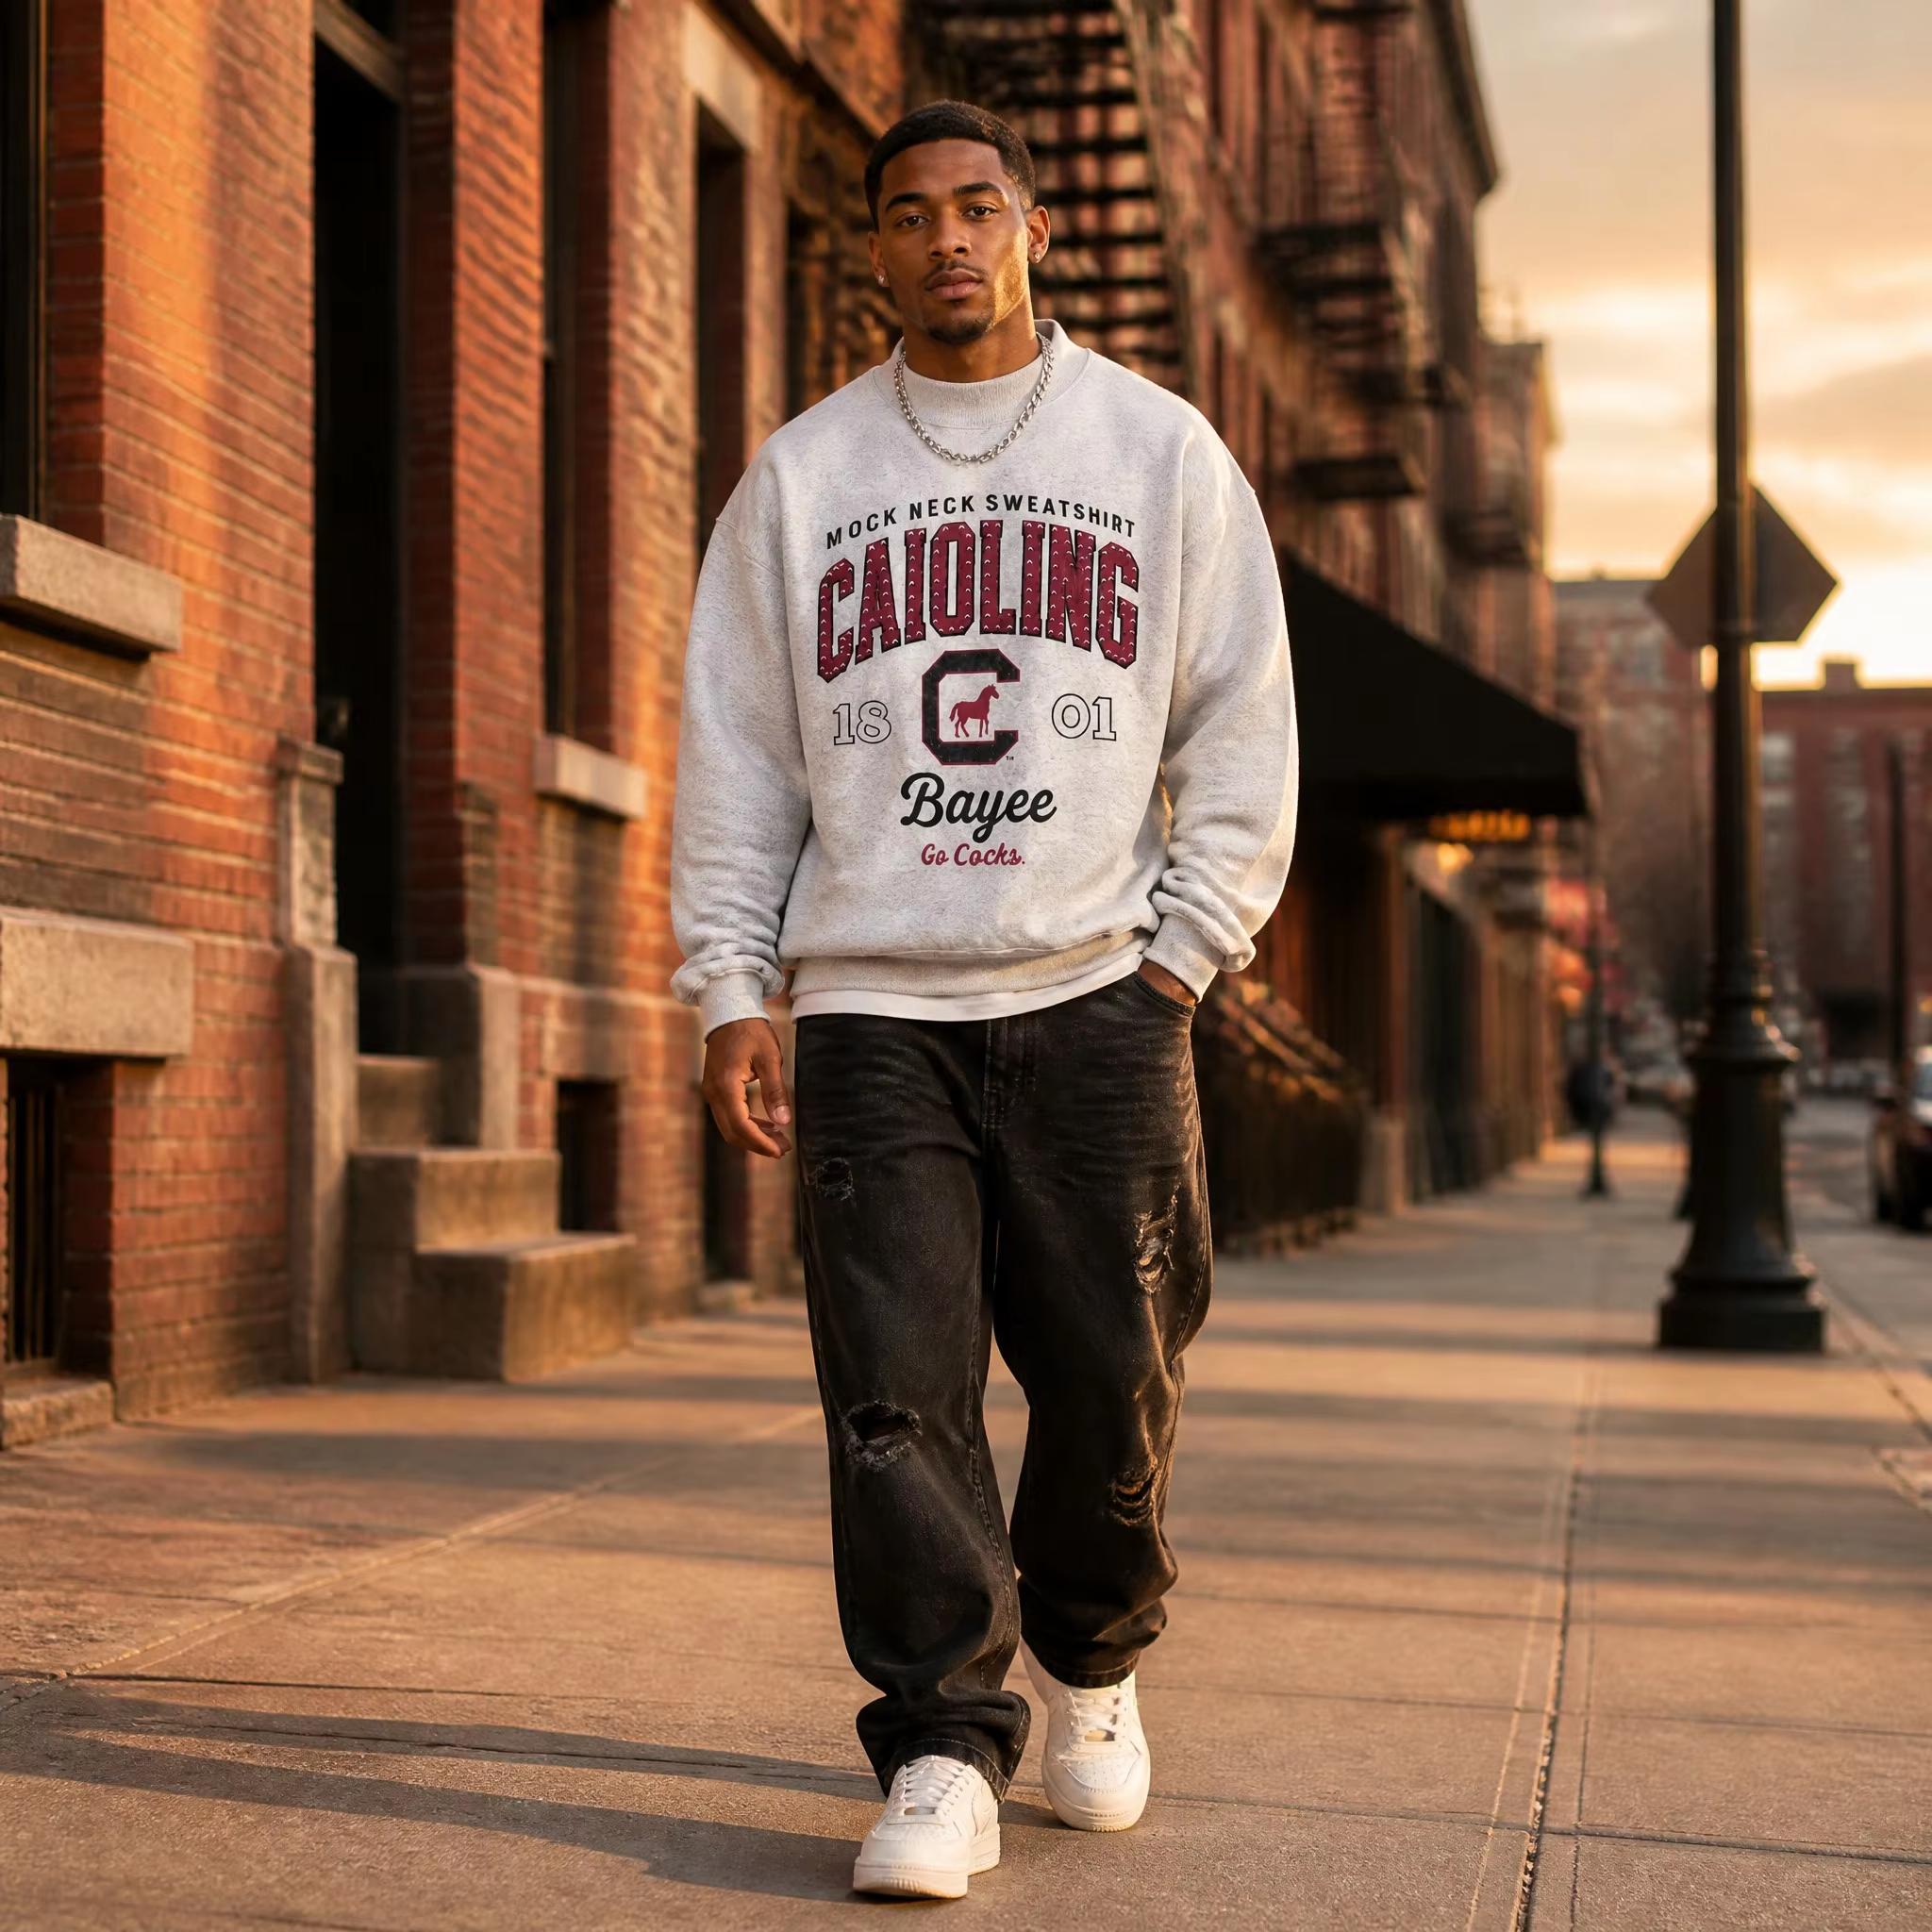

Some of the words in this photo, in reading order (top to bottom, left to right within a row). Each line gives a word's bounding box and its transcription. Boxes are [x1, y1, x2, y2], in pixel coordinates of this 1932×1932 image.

[825, 507, 897, 550] MOCK
[908, 495, 974, 520] NECK
[986, 494, 1136, 538] SWEATSHIRT
[817, 520, 1140, 683] CAIOLING
[833, 700, 891, 746] 18
[922, 649, 1021, 766] C
[1051, 693, 1117, 741] 01
[900, 773, 1058, 843] Bayee
[921, 843, 949, 866] Go
[954, 842, 1025, 866] Cocks.
